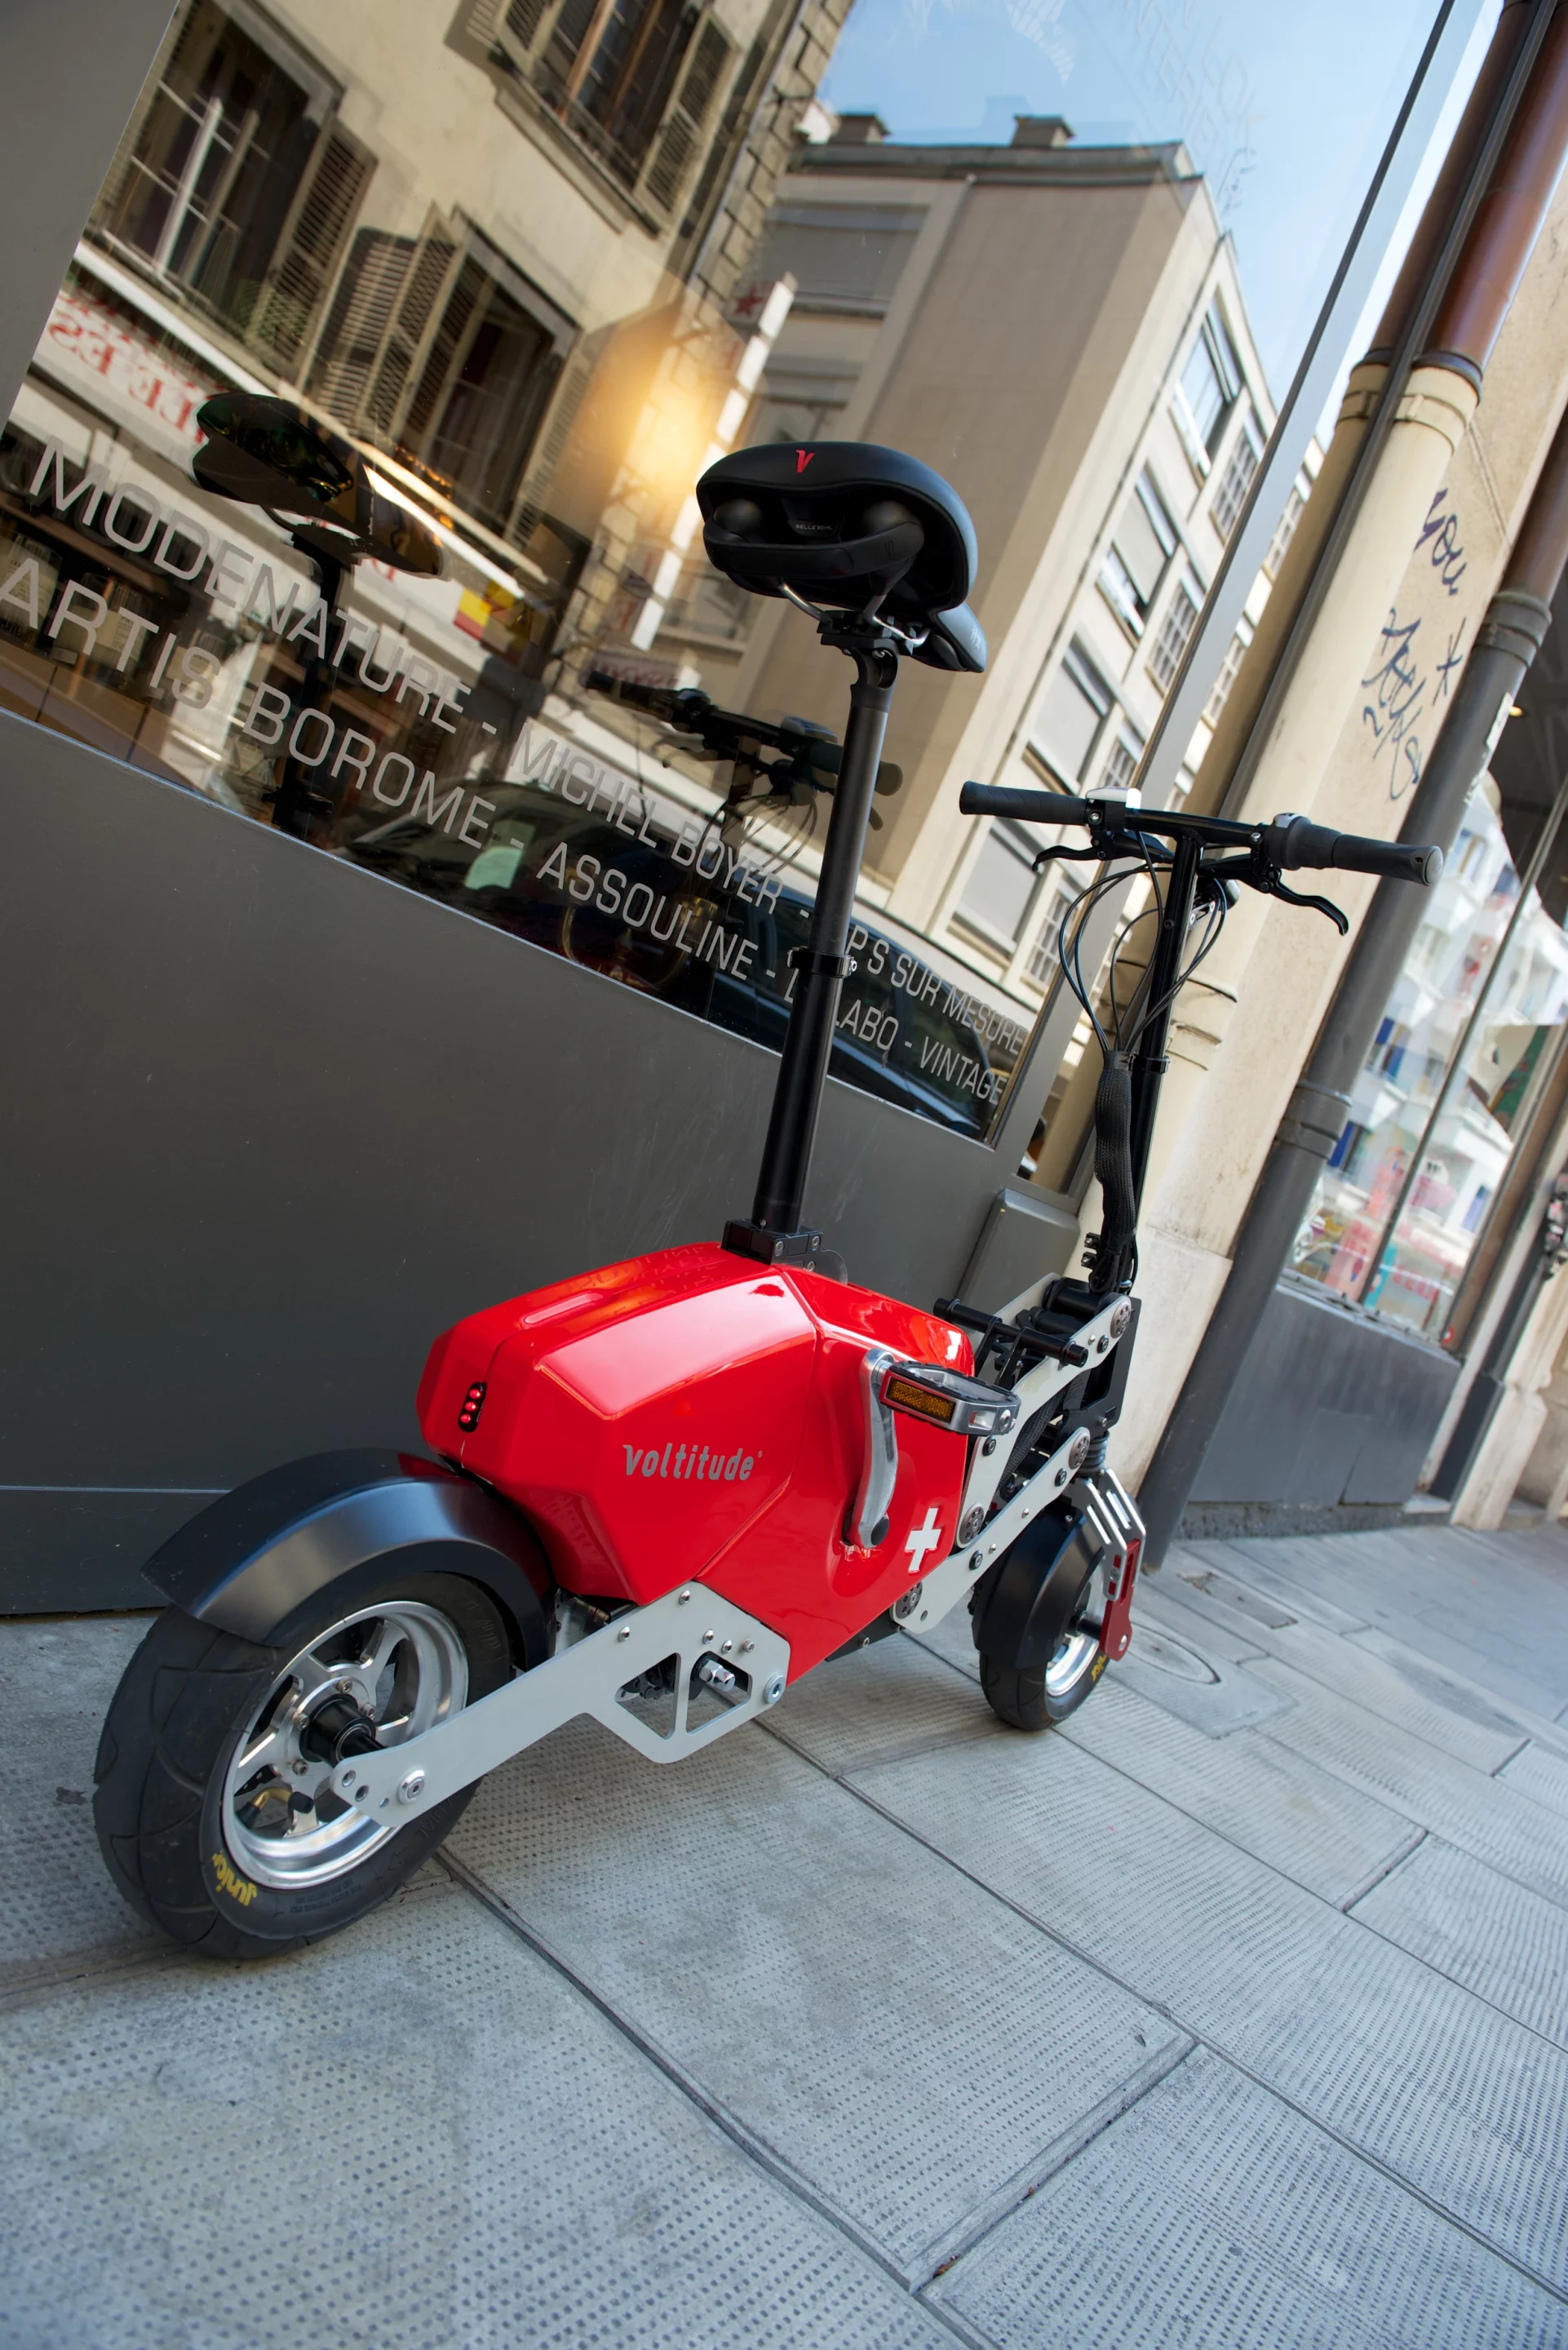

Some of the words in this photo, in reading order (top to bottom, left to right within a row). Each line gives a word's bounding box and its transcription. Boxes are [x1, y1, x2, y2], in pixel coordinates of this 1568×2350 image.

[0, 557, 221, 710] ARTIS
[243, 681, 497, 849] BOROME
[536, 841, 759, 981] ASSOULINE
[919, 1035, 1008, 1105] VINTAGE
[29, 435, 471, 734] MODENATURE
[509, 722, 657, 849] MICHEL
[671, 821, 784, 915] BOYER
[891, 953, 942, 1007] SUR
[942, 984, 1030, 1055] MESURE
